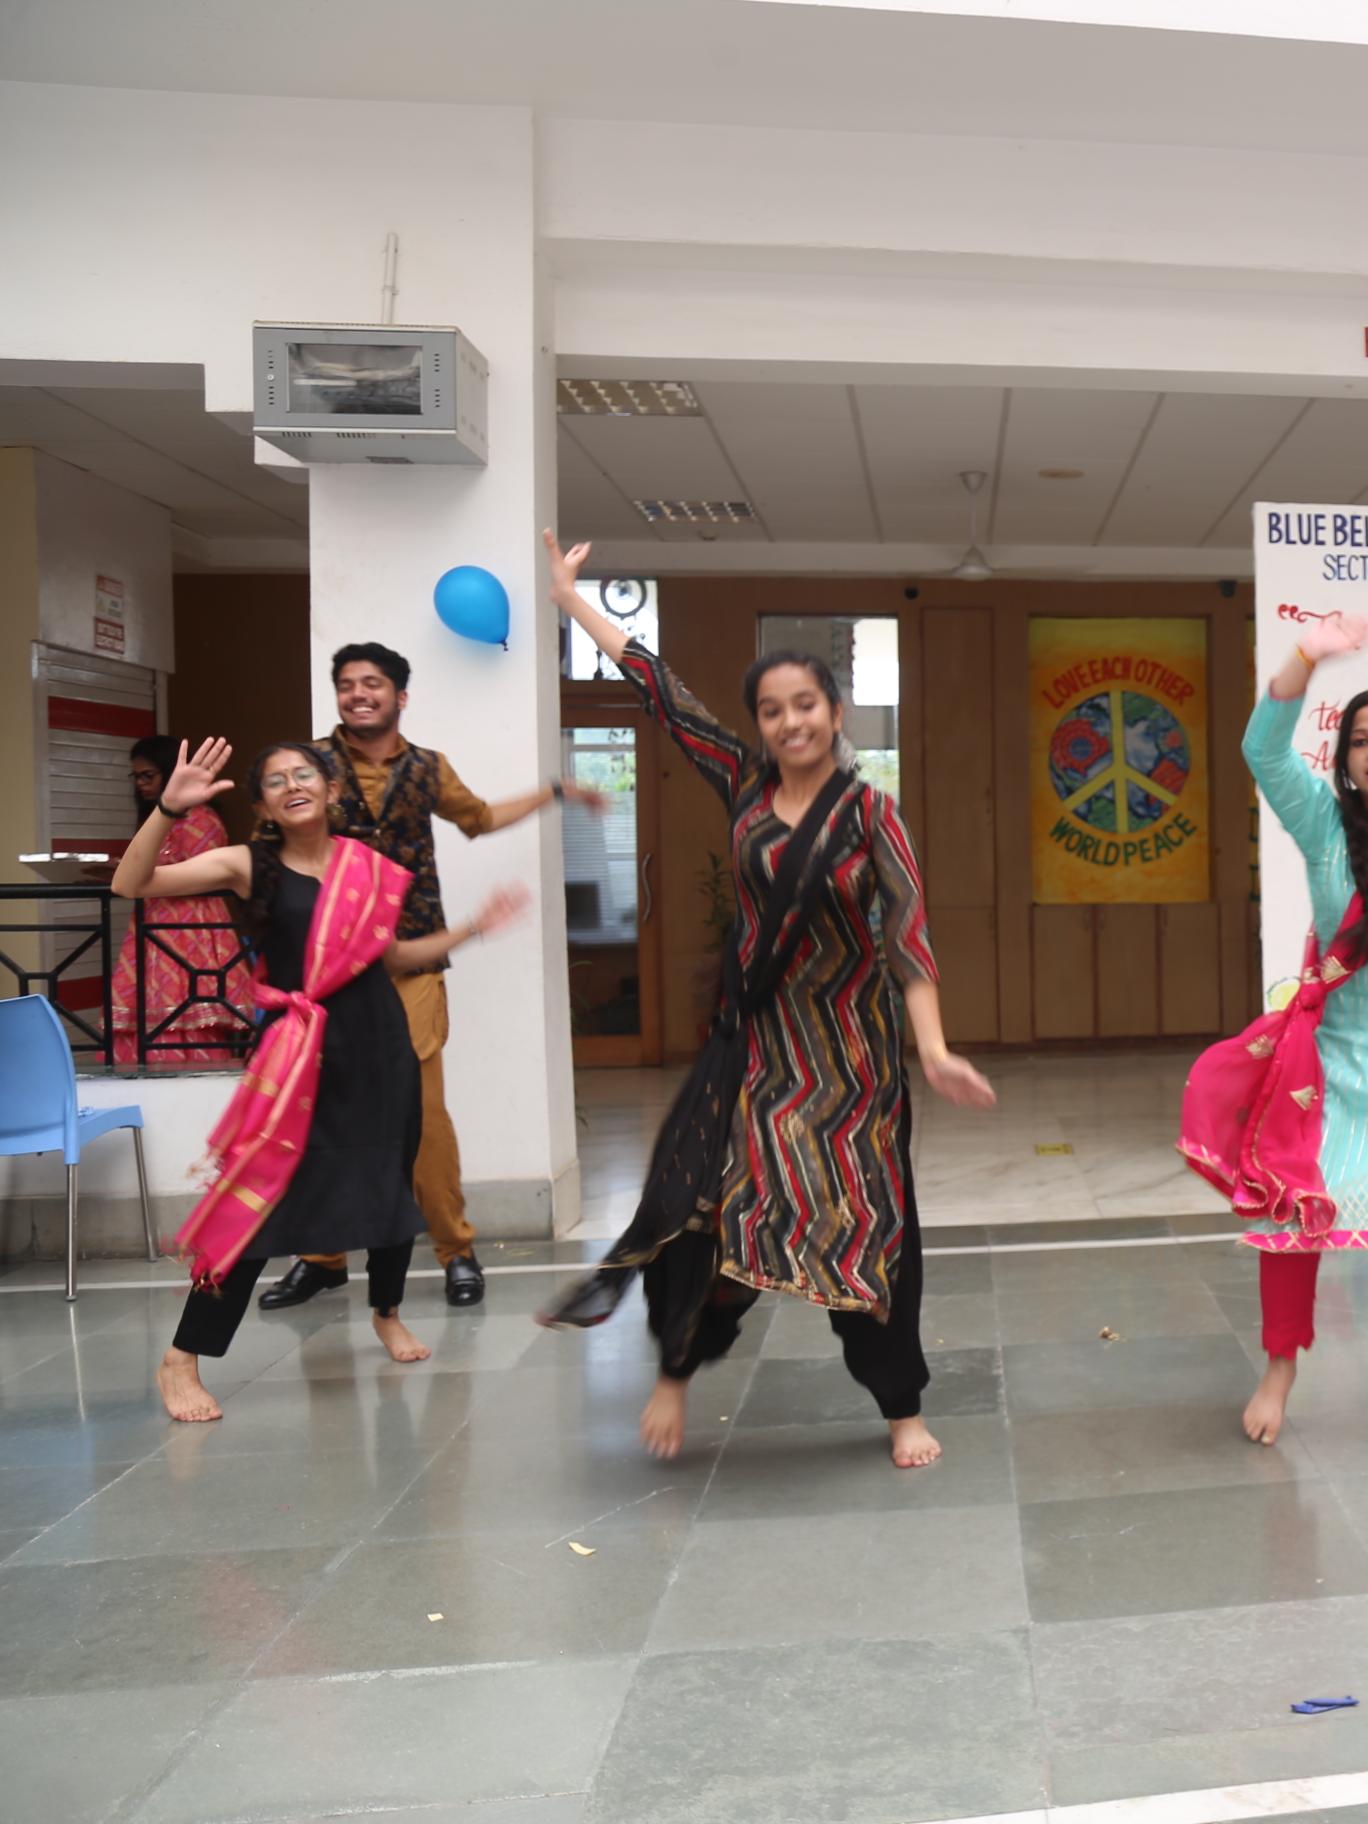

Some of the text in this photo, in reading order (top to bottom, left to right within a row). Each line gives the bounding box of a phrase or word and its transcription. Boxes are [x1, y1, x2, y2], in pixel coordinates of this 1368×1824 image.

[1268, 512, 1326, 545] BLUE
[1042, 656, 1195, 709] LOVE EACH OTHER
[1049, 812, 1198, 866] WORLD PEACE
